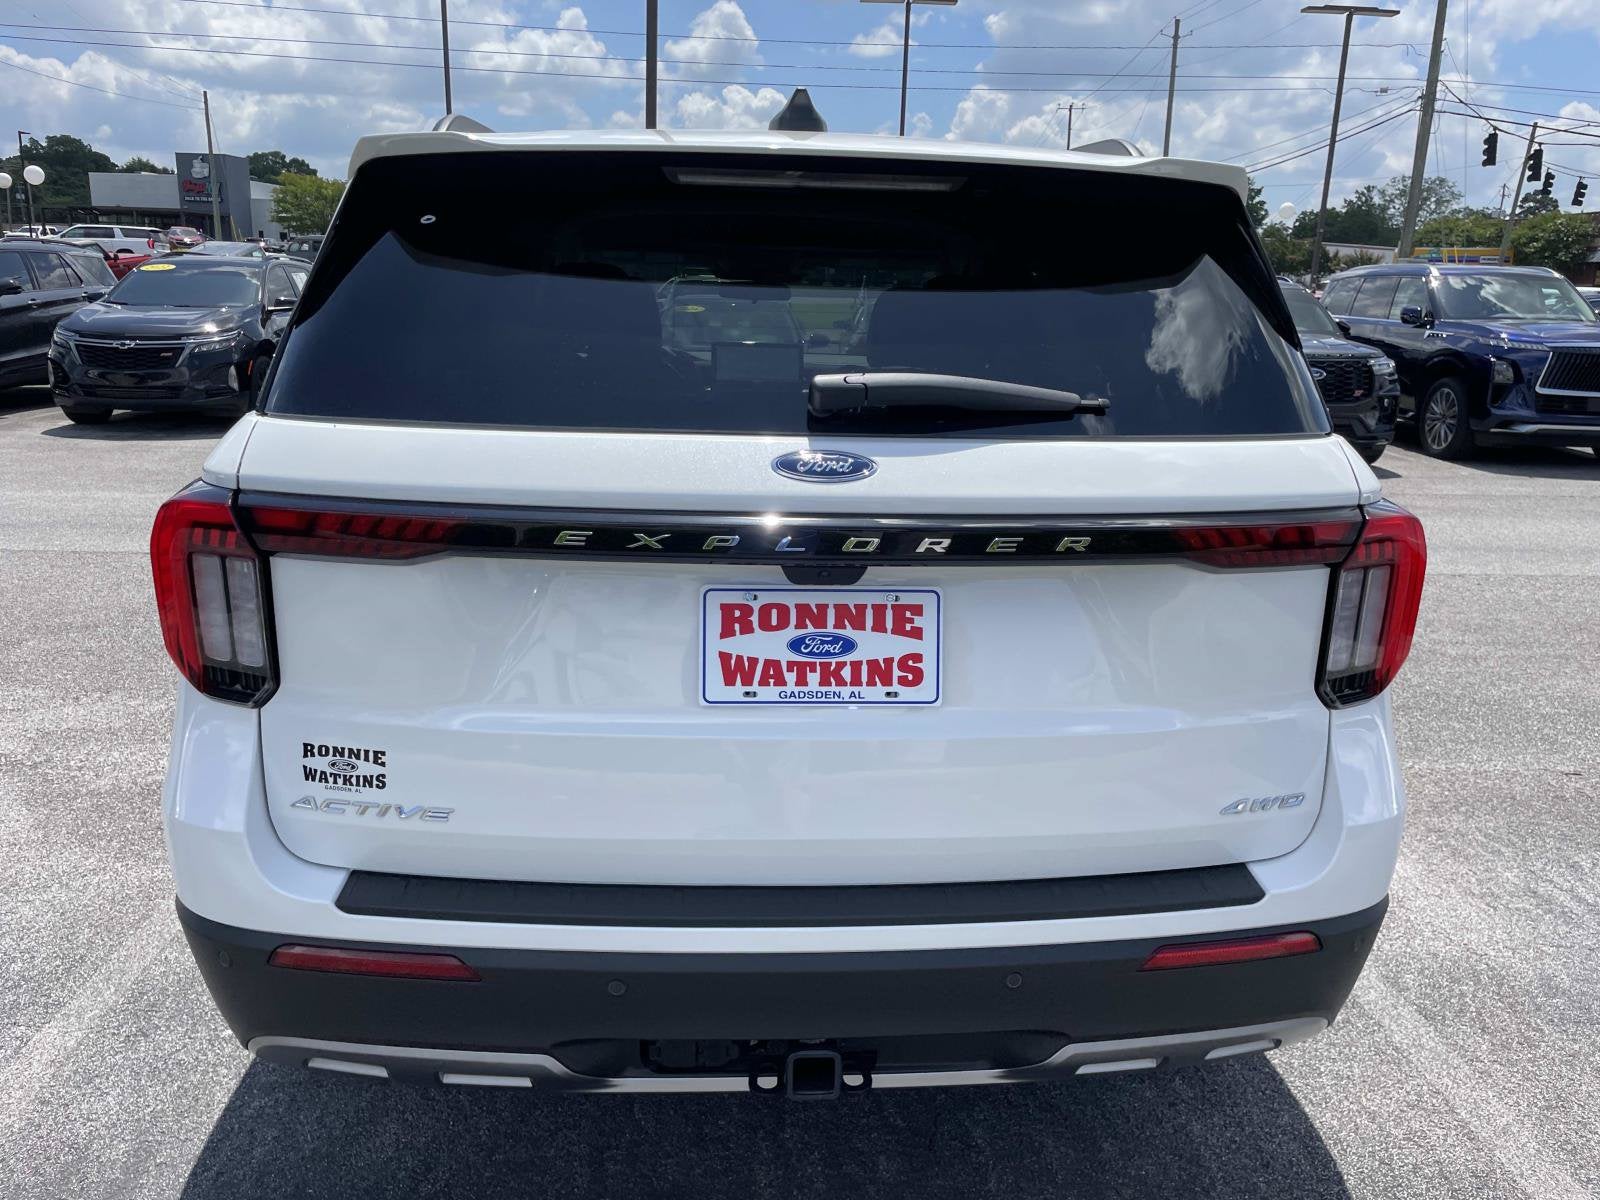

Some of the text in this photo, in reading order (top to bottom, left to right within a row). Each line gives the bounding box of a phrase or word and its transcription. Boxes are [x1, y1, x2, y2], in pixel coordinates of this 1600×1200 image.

[797, 451, 854, 473] Ford
[554, 530, 1093, 553] EXPLORER
[719, 602, 924, 641] RONNIE
[800, 636, 843, 654] Ford
[718, 650, 925, 688] WATKINS
[778, 690, 866, 701] GADSDEN, AL
[302, 742, 387, 768] RONNIE
[302, 764, 387, 790] WATKINS
[290, 795, 456, 822] ACTIVE
[1219, 792, 1305, 815] 4WD
